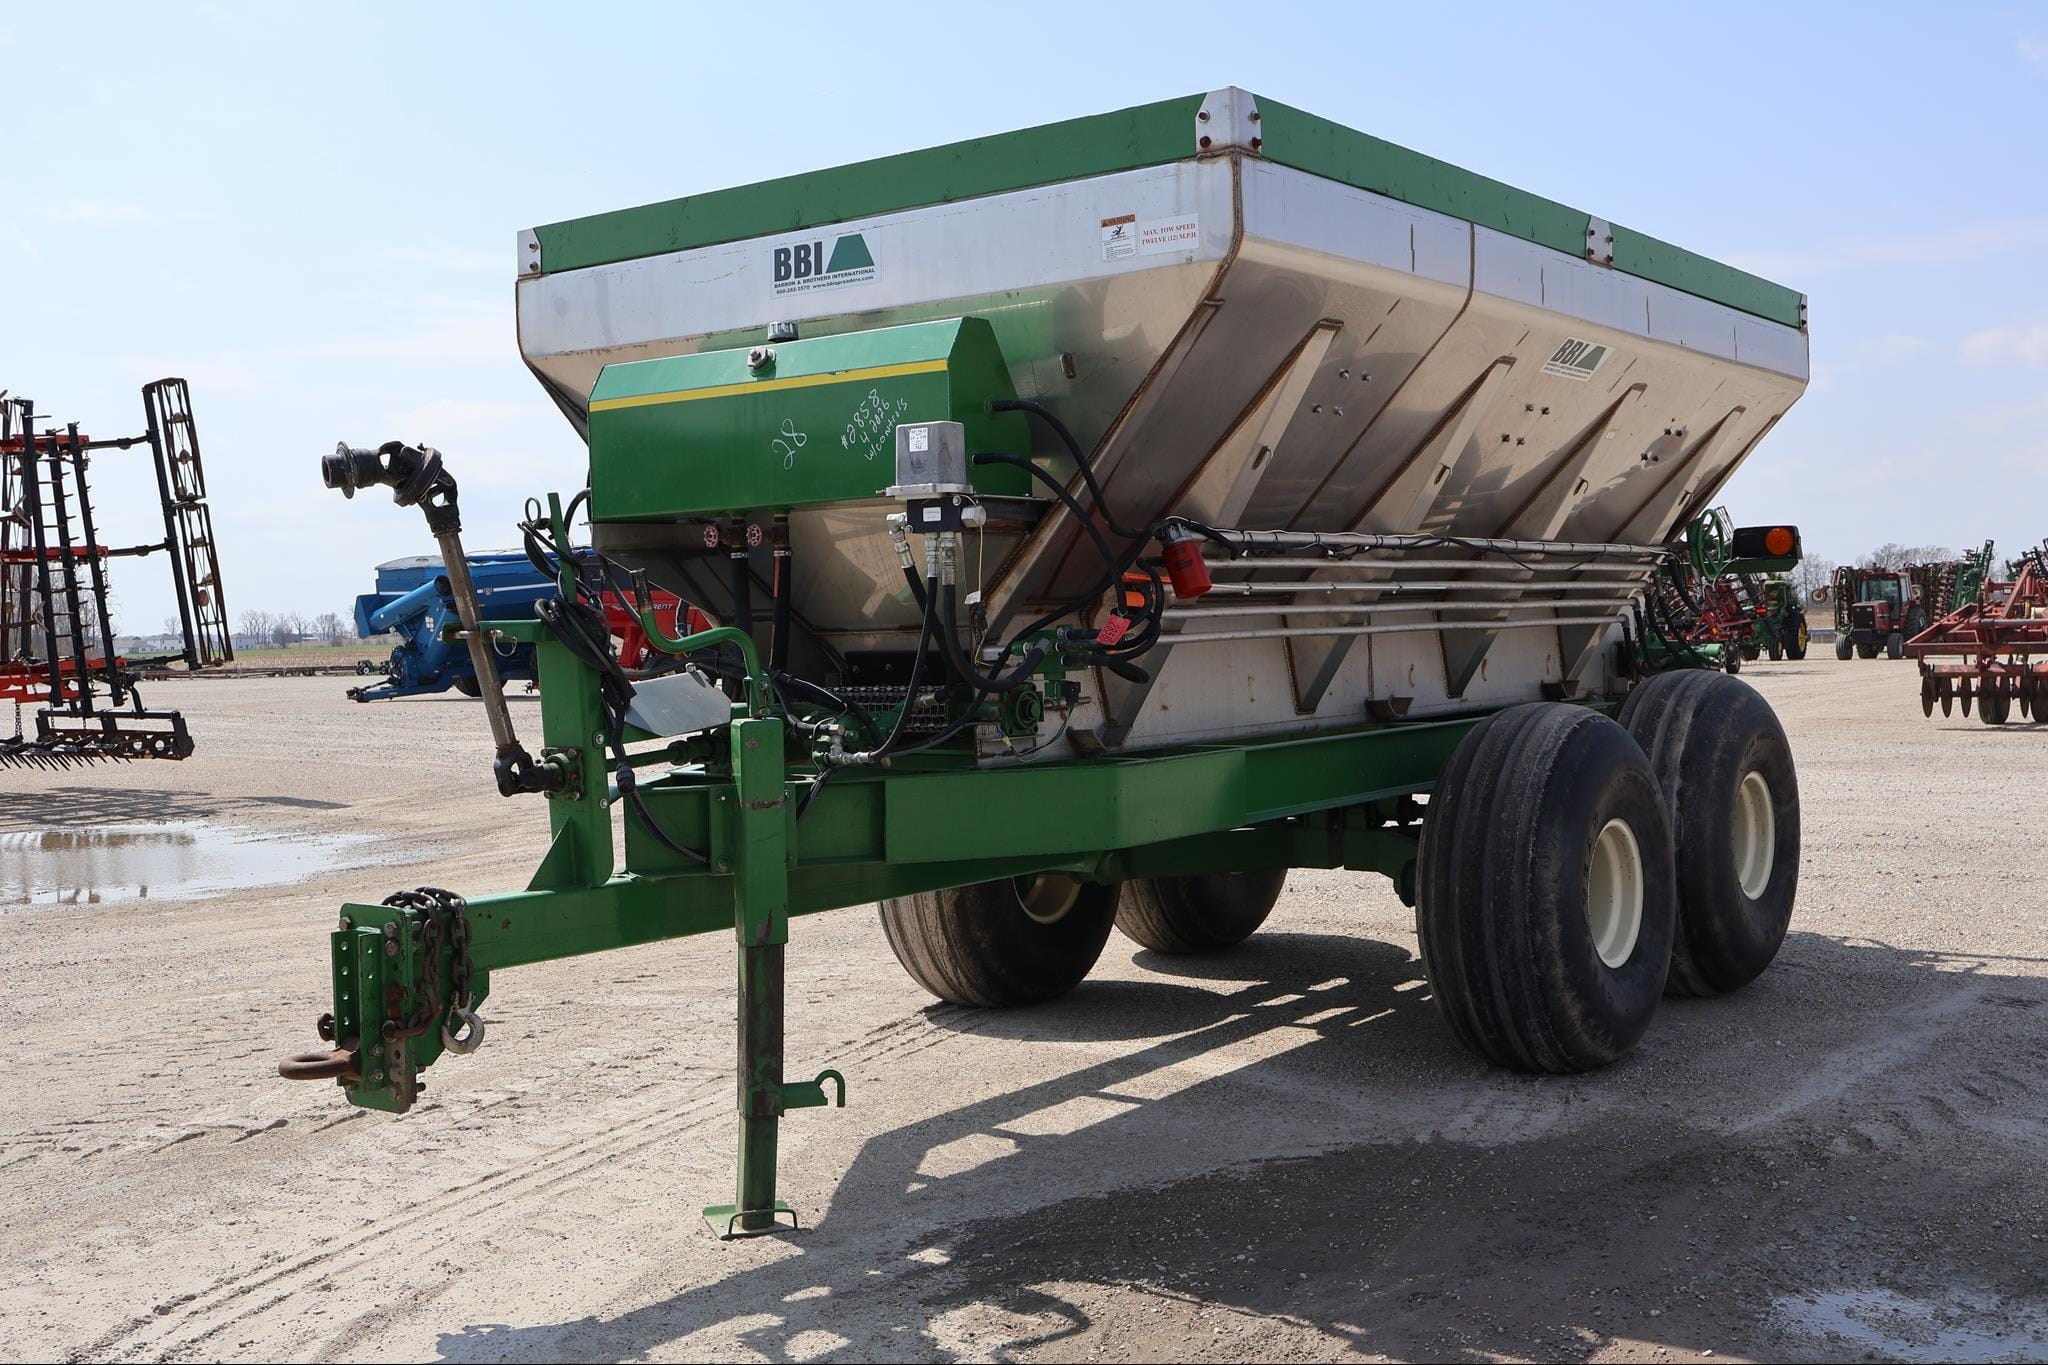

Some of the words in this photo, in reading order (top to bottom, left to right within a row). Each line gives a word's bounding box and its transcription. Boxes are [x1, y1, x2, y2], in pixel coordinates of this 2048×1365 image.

[1160, 226, 1174, 234] TOW
[1175, 223, 1196, 231] SPEED
[1141, 236, 1166, 245] TWELVE
[774, 241, 823, 282] BBI
[774, 281, 796, 289] BARRON
[803, 275, 831, 284] BROTHERS
[832, 268, 875, 279] INTERNATIONAL
[812, 276, 874, 288] www.bbispreaders.com
[1550, 338, 1591, 366] BBI
[840, 388, 880, 449] #2858
[771, 418, 807, 470] 28
[1101, 621, 1121, 641] 2858
